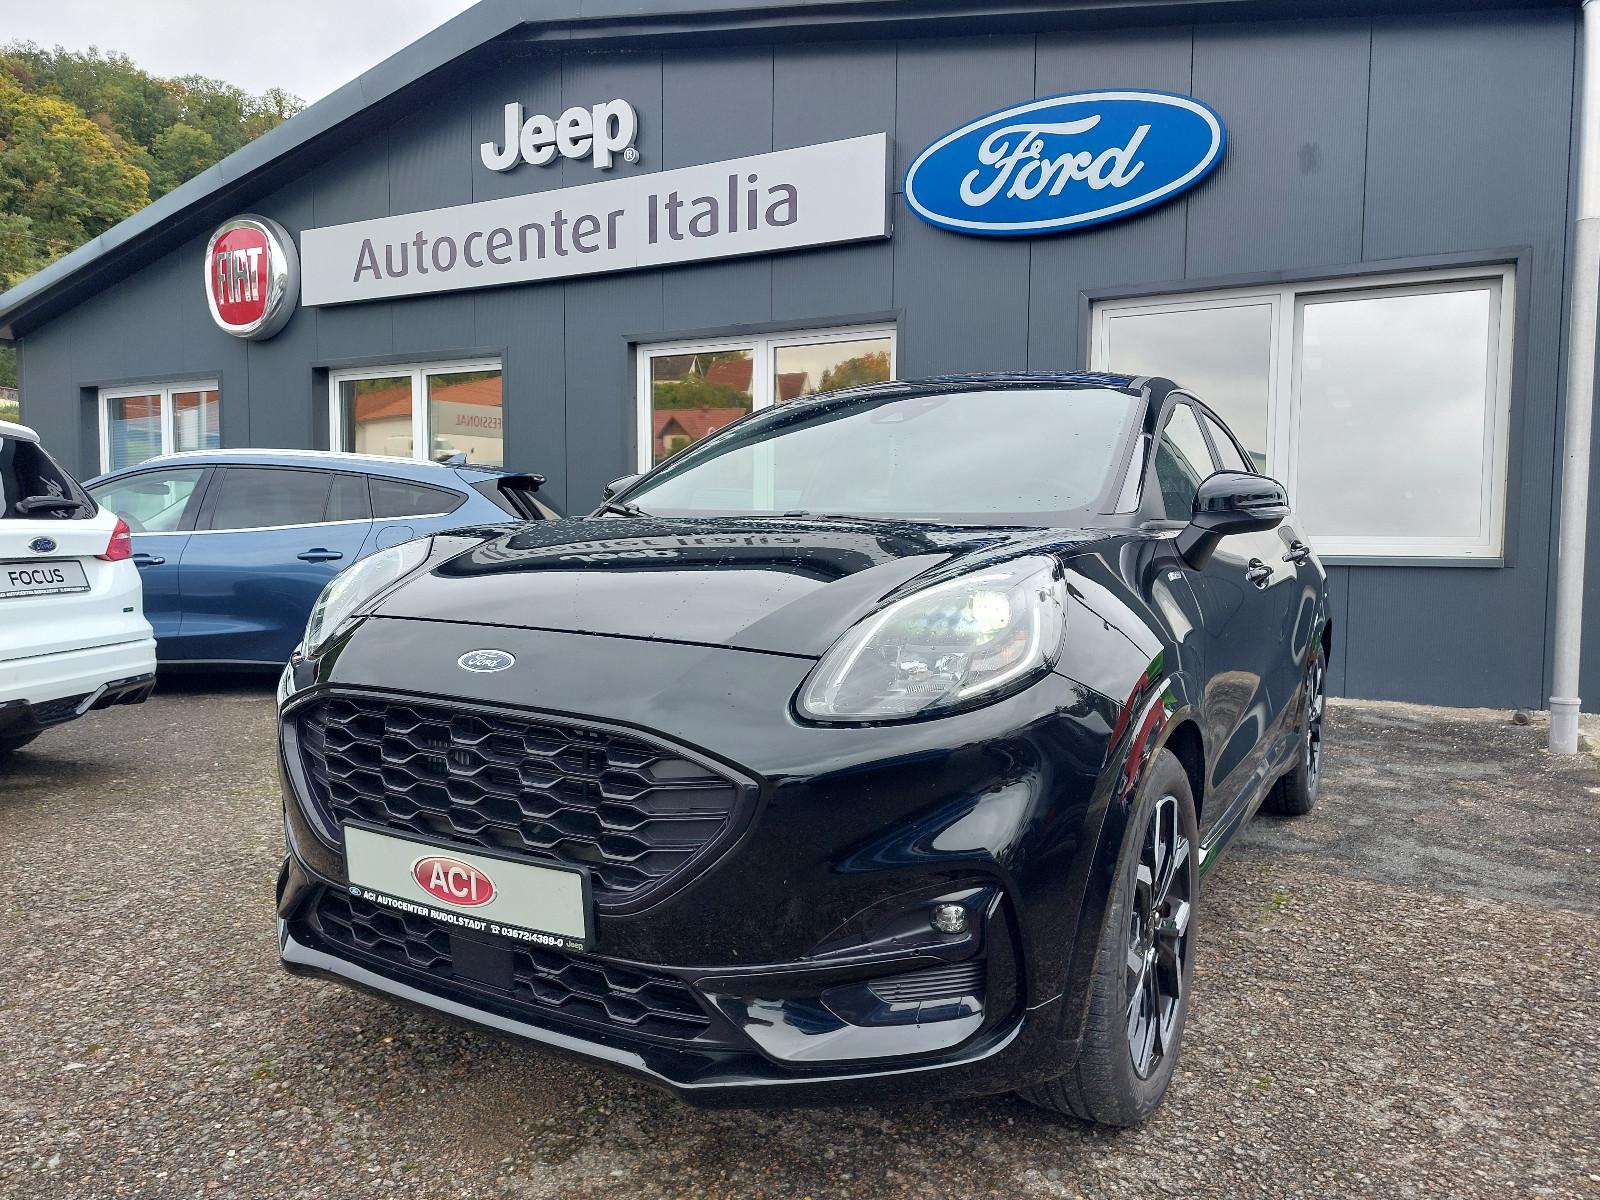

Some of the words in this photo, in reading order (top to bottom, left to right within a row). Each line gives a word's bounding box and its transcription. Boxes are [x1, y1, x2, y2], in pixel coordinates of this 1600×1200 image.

[959, 114, 1152, 207] Ford
[353, 208, 625, 283] Autocenter
[648, 173, 798, 245] Italia
[217, 246, 263, 305] FIAT
[7, 568, 65, 586] FOCUS
[467, 651, 501, 668] Ford
[430, 861, 478, 901] ACI
[363, 890, 376, 902] ACI
[377, 895, 429, 917] AUTOCENTER
[430, 909, 487, 931] RUDOLSTADT
[566, 940, 584, 951] Jeep
